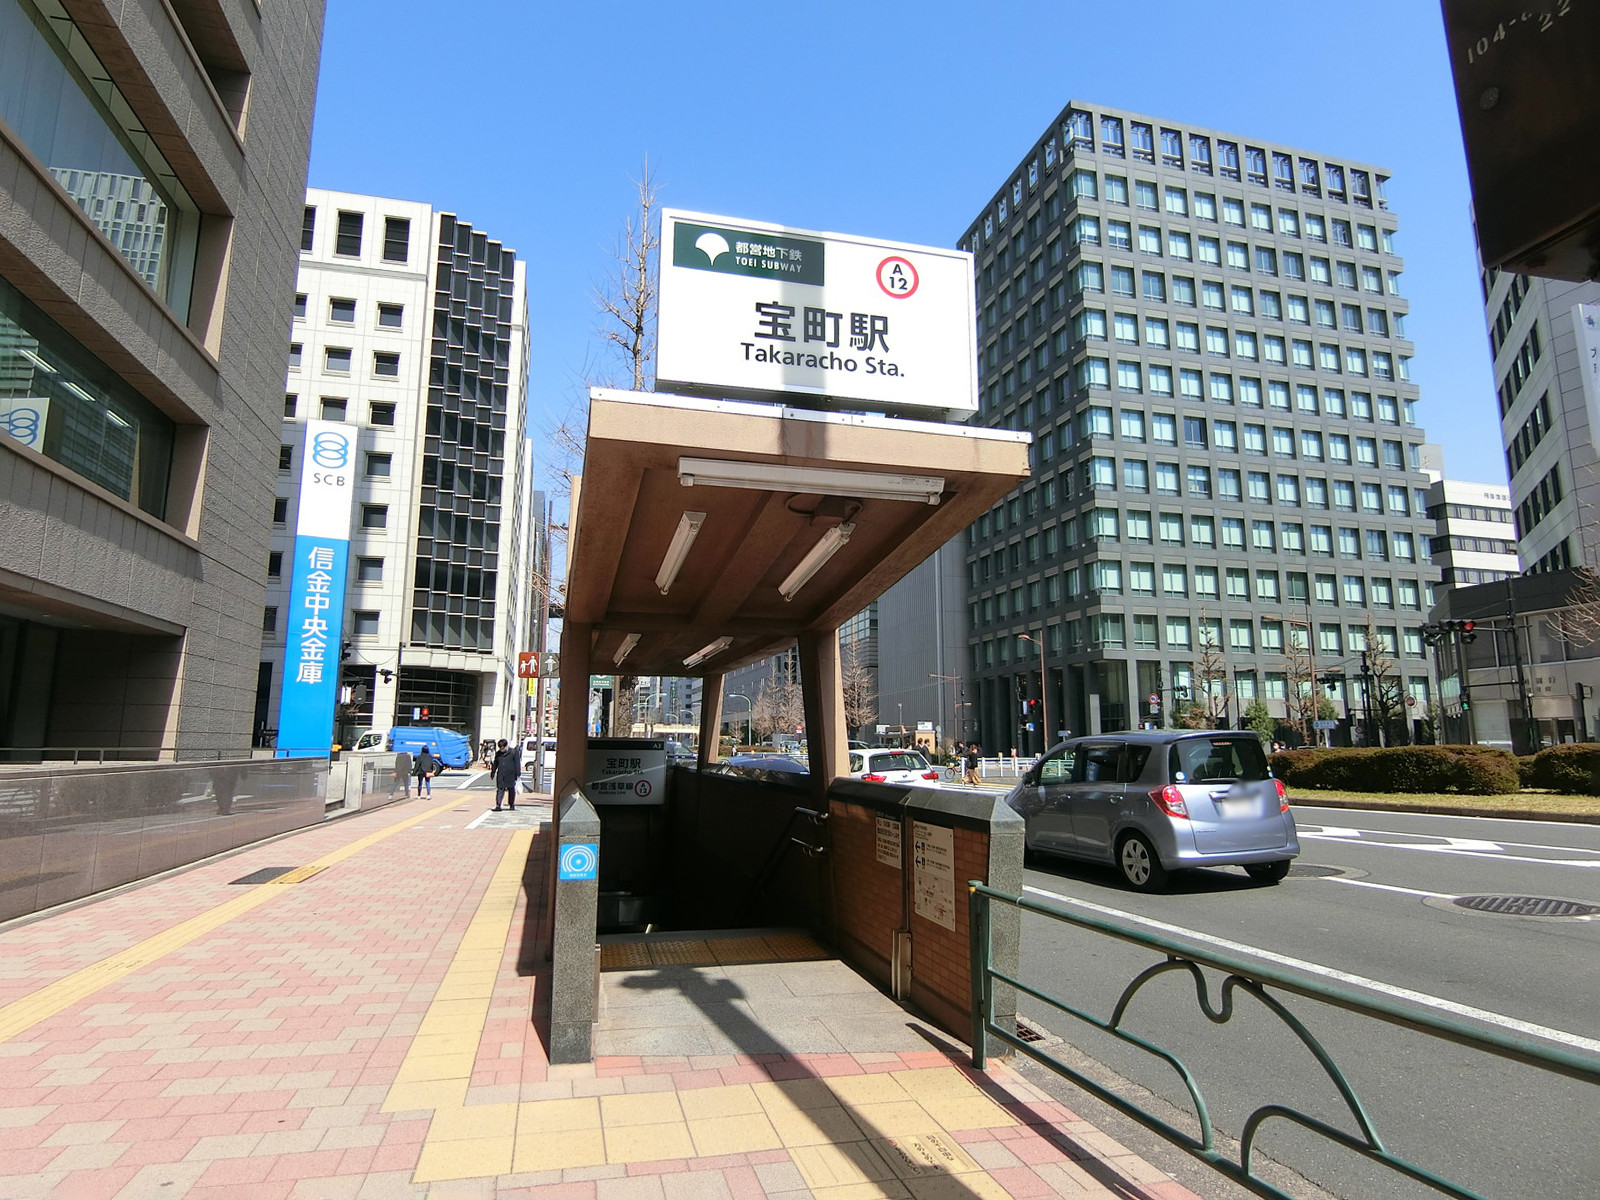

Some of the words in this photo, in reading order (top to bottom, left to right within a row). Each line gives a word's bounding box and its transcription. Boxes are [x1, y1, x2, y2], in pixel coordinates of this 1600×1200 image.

[735, 241, 802, 262] 都営地下鉄
[735, 256, 757, 268] TOEI
[761, 260, 802, 273] SUBWAY
[892, 263, 903, 276] A
[889, 276, 908, 290] 12
[754, 301, 890, 353] 宝町駅
[740, 342, 858, 373] Takaracho
[865, 357, 905, 377] Sta.
[313, 473, 346, 487] SCB
[296, 546, 335, 685] 信金中央金庫
[606, 758, 641, 769] 宝町駅
